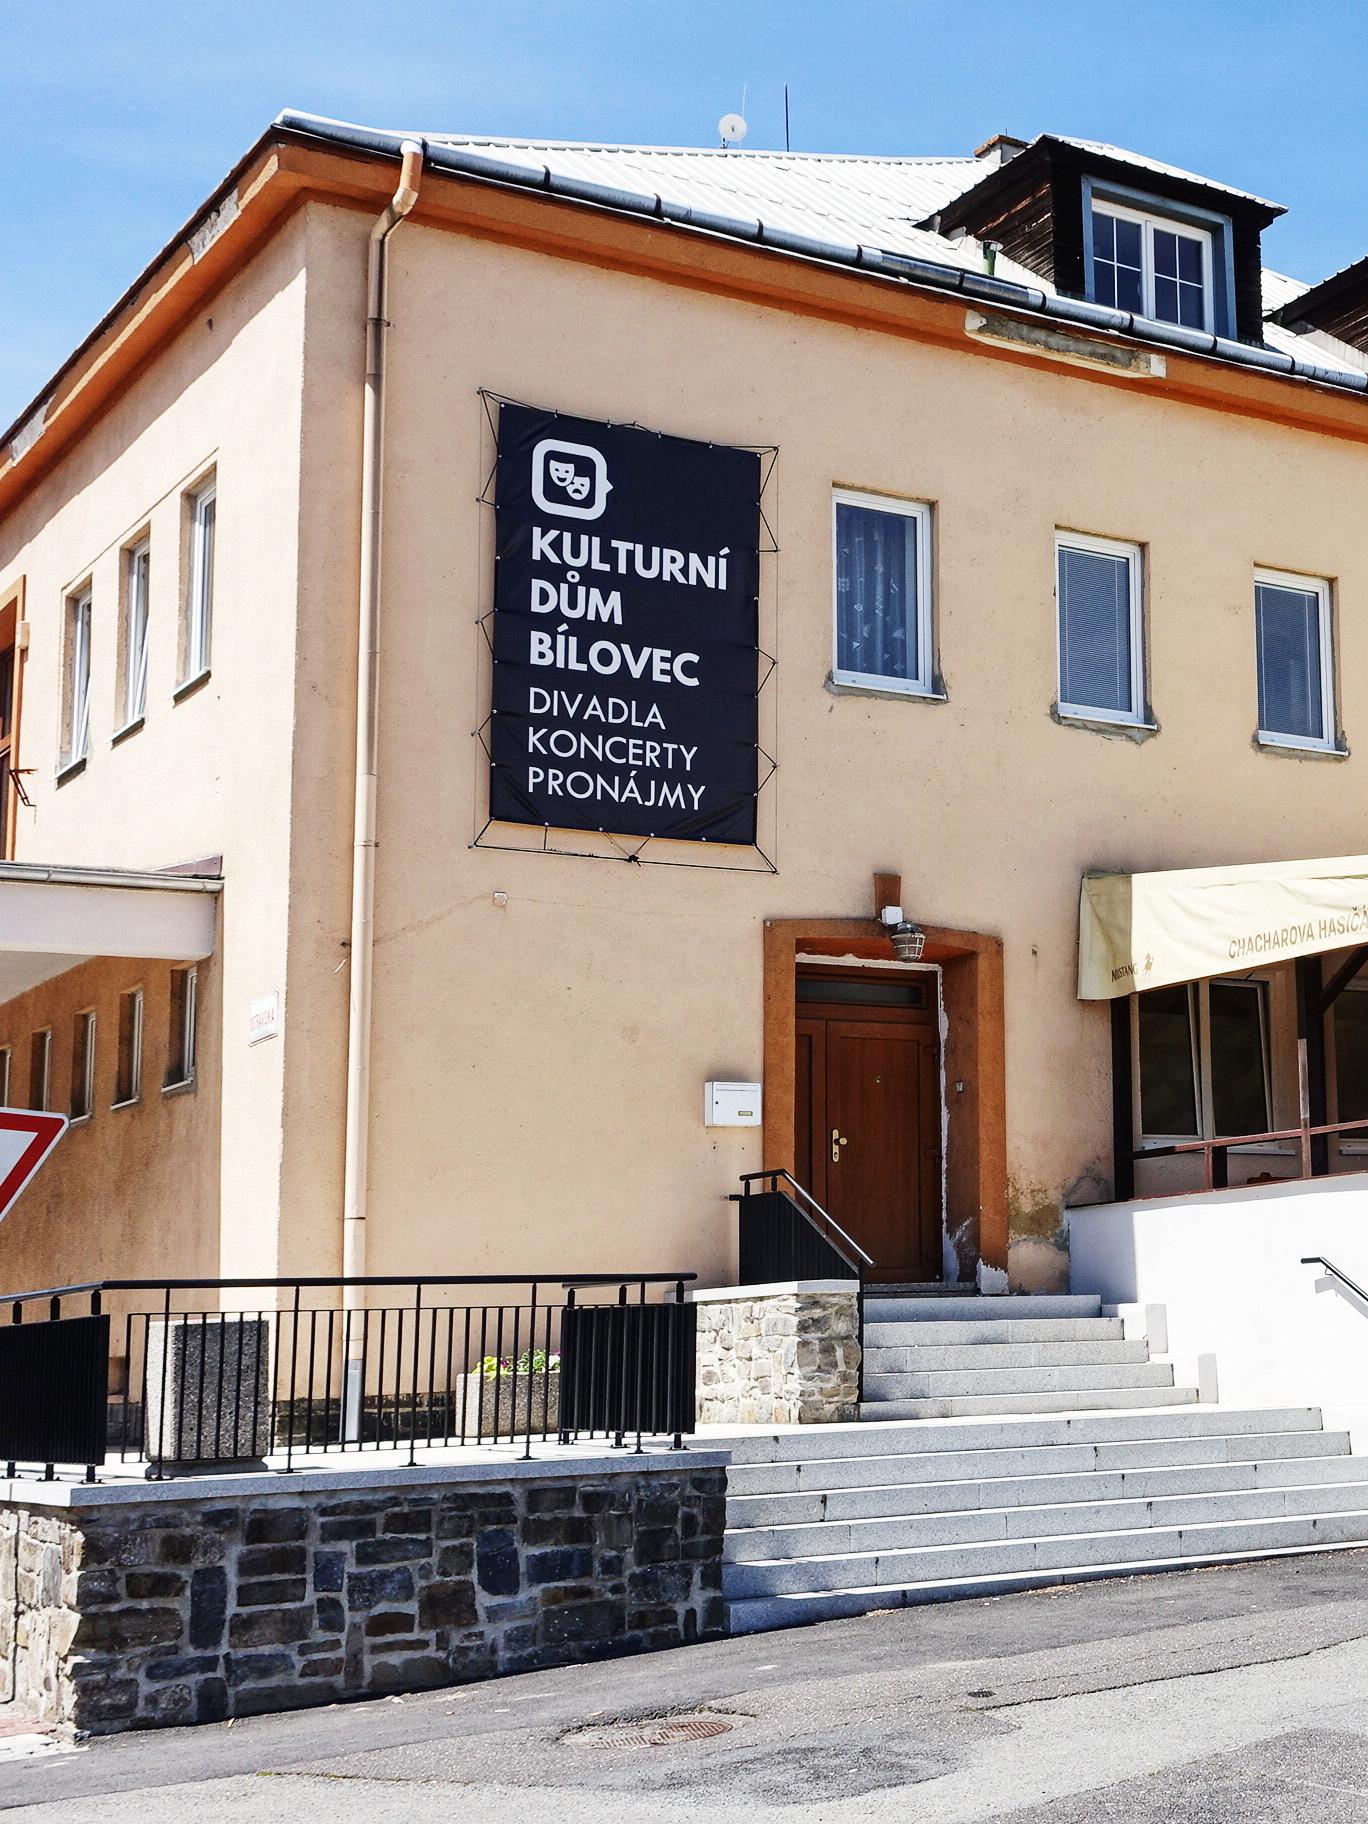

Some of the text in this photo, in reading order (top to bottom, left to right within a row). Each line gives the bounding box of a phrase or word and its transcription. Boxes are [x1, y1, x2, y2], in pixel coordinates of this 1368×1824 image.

[532, 526, 730, 590] KULTURNÍ
[530, 570, 623, 625] DŮM
[529, 623, 700, 687] BÍLOVEC
[528, 687, 666, 730] DIVADLA
[528, 727, 698, 771] KONCERTY
[528, 767, 706, 811] PRONÁJMY
[1228, 922, 1315, 959] CHACHAROVA
[1111, 962, 1139, 982] MUSTANG
